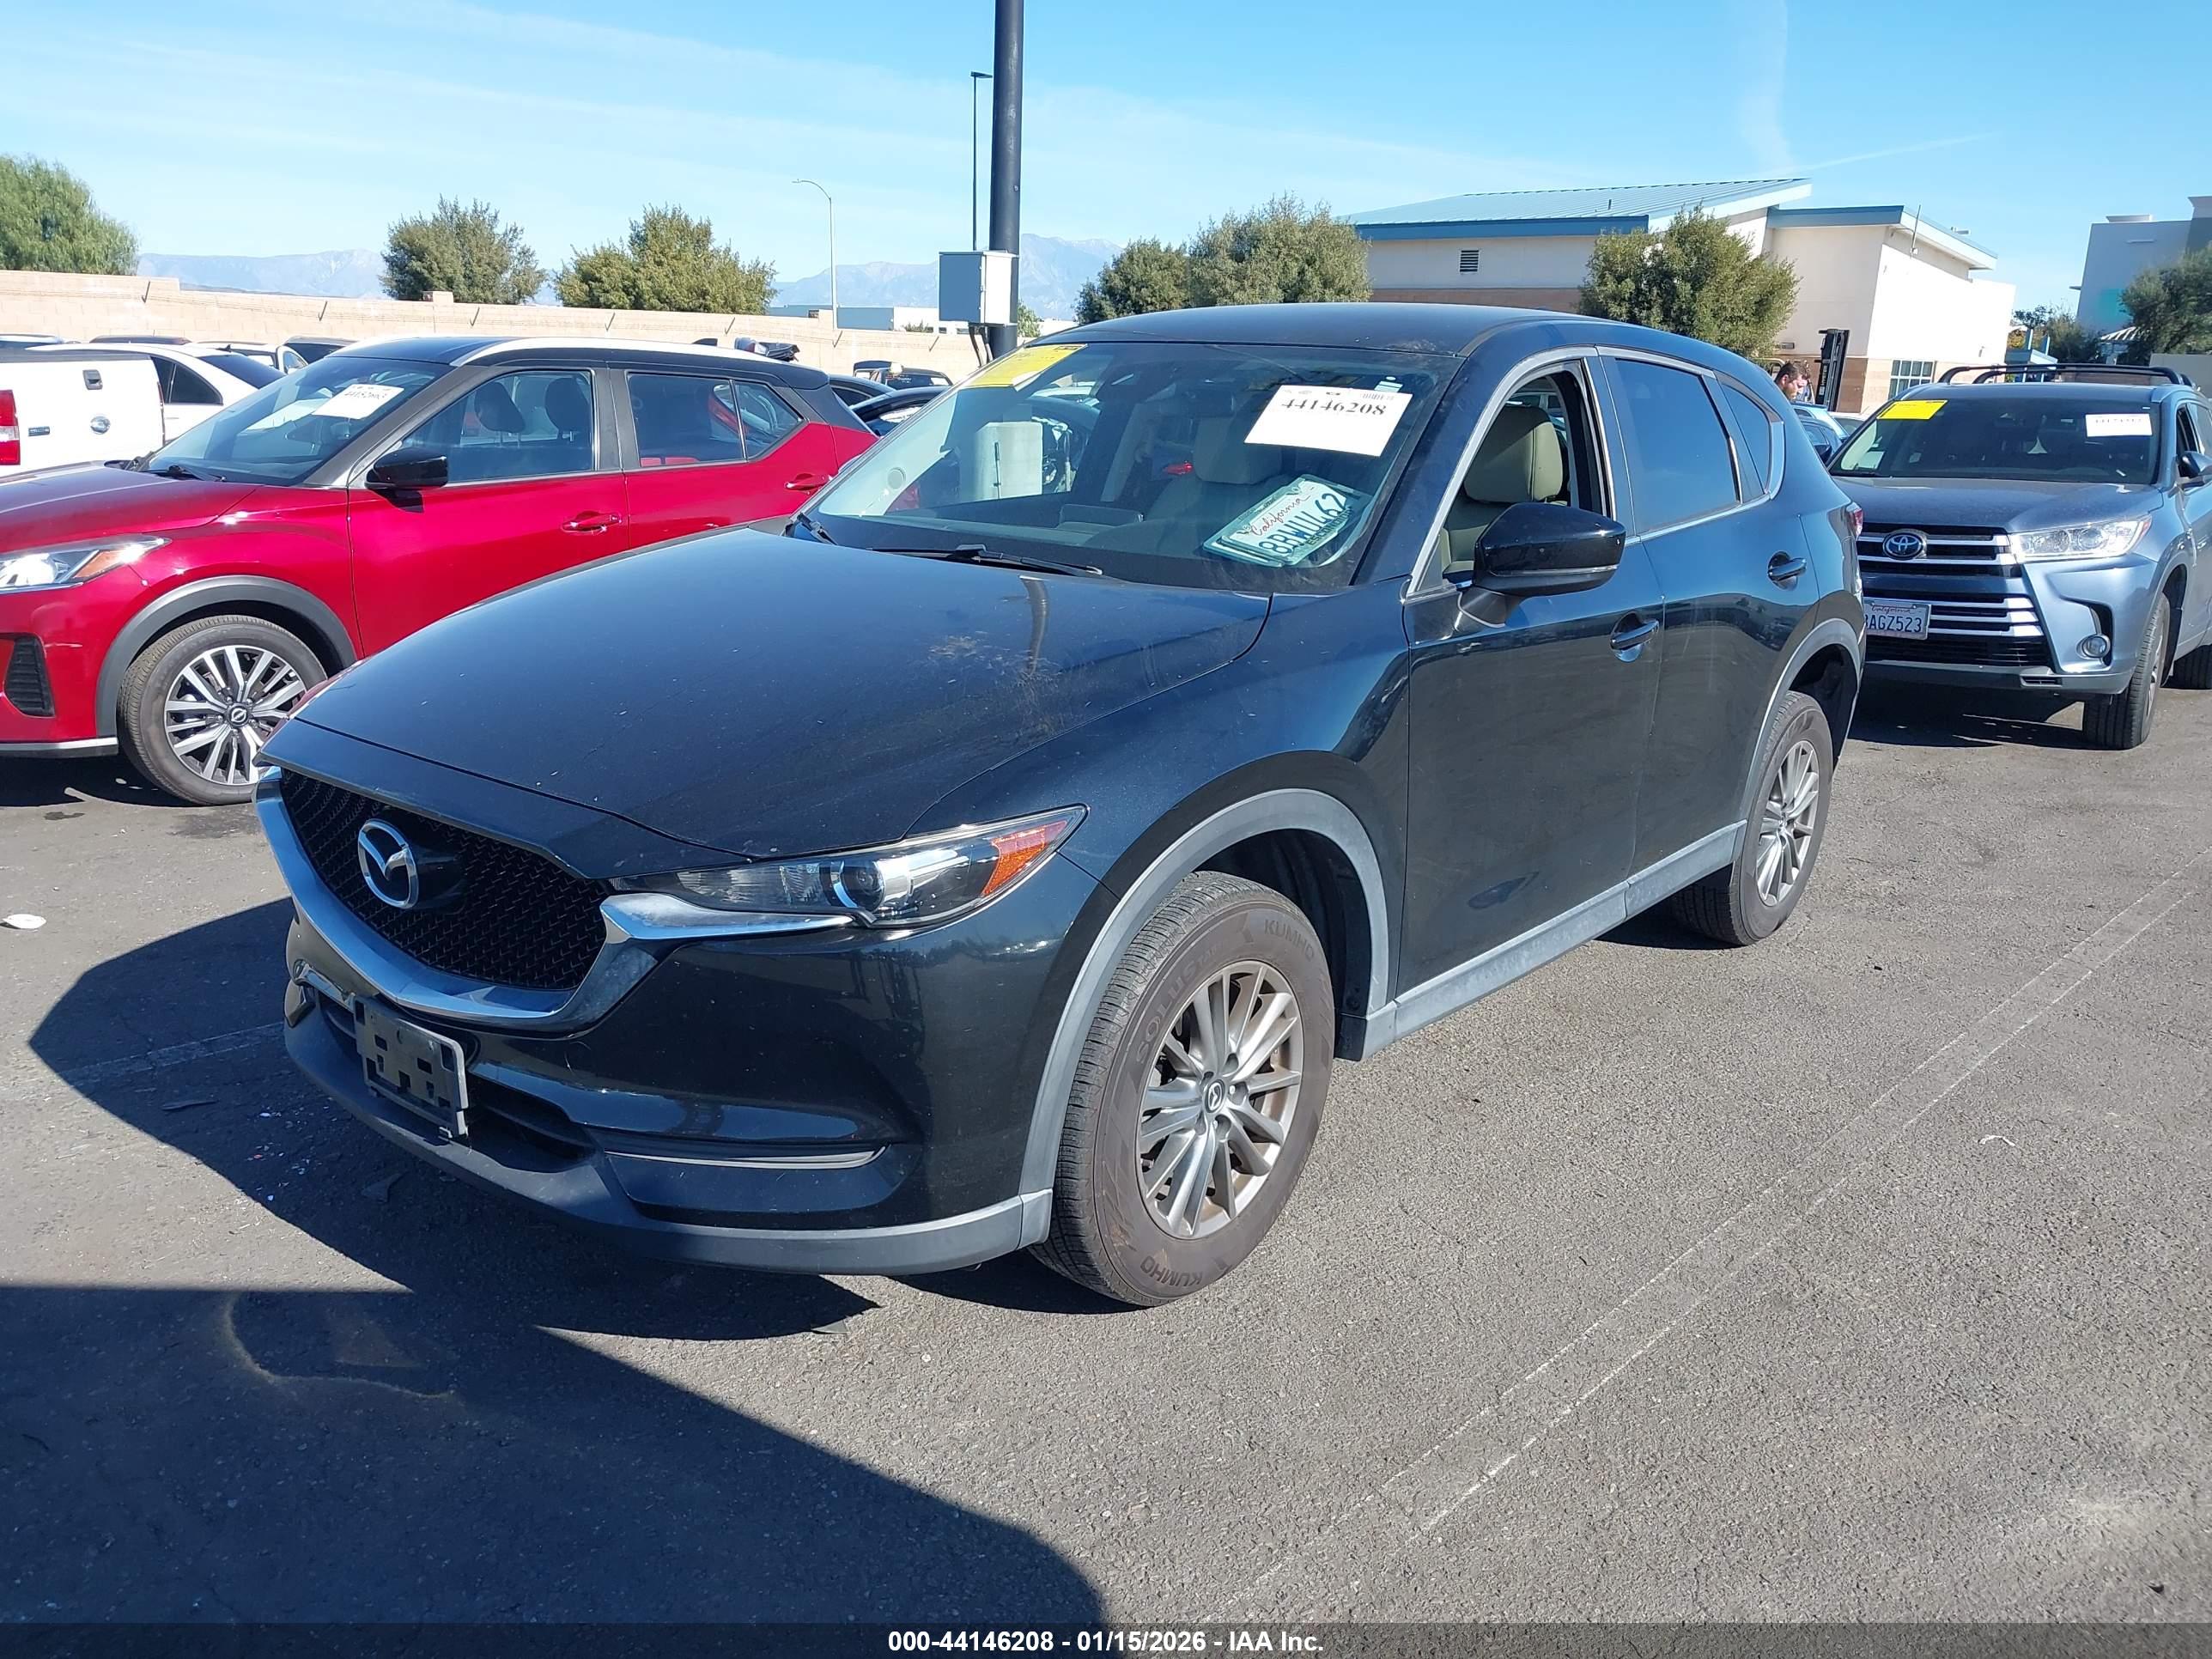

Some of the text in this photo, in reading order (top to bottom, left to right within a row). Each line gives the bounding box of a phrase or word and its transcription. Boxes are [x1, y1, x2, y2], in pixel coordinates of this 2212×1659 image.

[1282, 398, 1386, 415] 44146208
[1249, 495, 1311, 536] California
[1259, 493, 1346, 555] 8BWU462
[1265, 919, 1314, 961] KUMHO
[1136, 959, 1196, 1064] SOLUS
[1140, 1255, 1202, 1286] KUMHO
